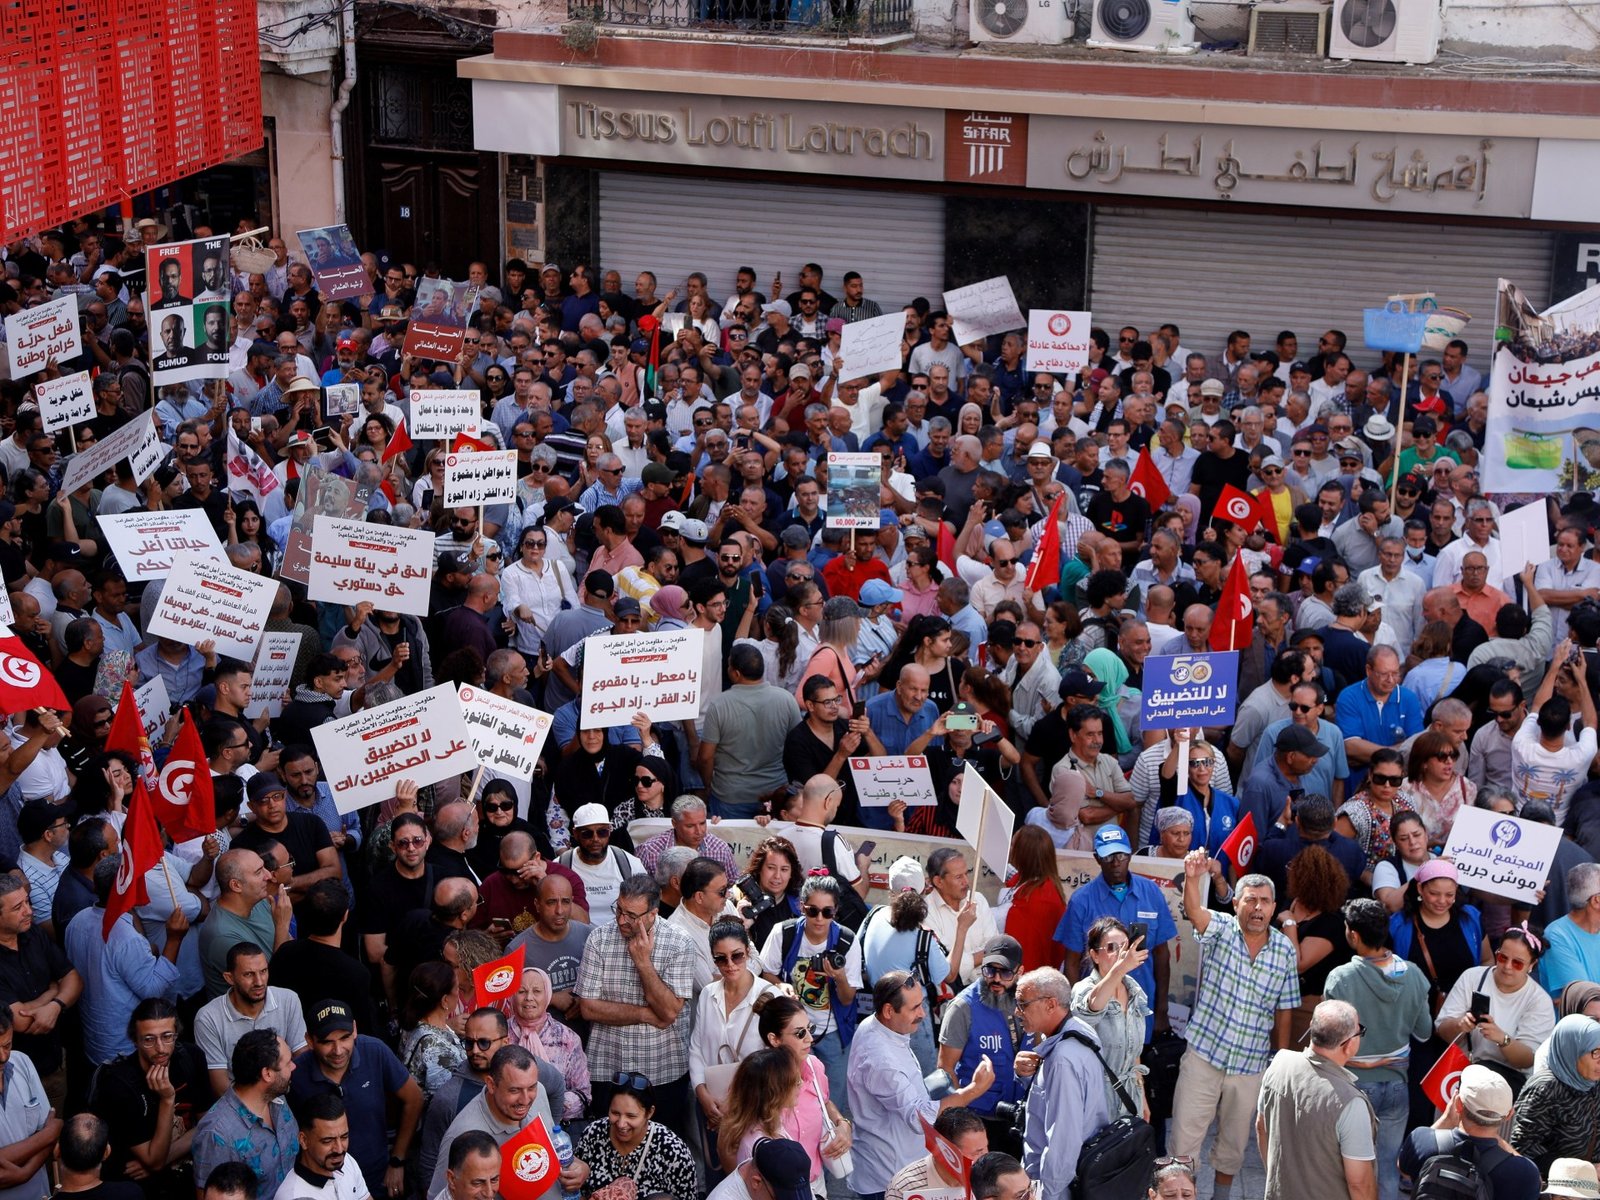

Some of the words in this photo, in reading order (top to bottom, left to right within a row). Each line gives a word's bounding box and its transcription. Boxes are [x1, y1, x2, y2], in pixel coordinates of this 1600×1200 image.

[568, 100, 675, 144] Tissus
[685, 105, 775, 150] Lotfi
[784, 112, 934, 161] Latrach
[1214, 140, 1360, 200] لطفي
[1373, 139, 1495, 208] أقمشة
[401, 208, 410, 217] 18
[160, 247, 180, 256] FREE
[205, 241, 221, 250] THE
[48, 319, 73, 341] شغل
[48, 338, 75, 356] كرامة
[415, 341, 437, 350] العثماني
[1029, 340, 1049, 349] عادلة
[1051, 341, 1080, 351] محاكمة
[17, 349, 45, 368] وطنية
[158, 357, 188, 368] SUMUD
[1033, 360, 1044, 368] حر
[1046, 359, 1063, 370] دفاع
[1065, 360, 1080, 370] دون
[1508, 365, 1572, 388] جيعان
[70, 388, 83, 401] شغل
[1506, 389, 1565, 412] شبعان
[71, 404, 91, 418] كرامة
[419, 405, 432, 416] عمال
[475, 469, 480, 480] يا
[482, 468, 504, 480] مواطن
[505, 466, 511, 478] يا
[447, 491, 467, 503] الجوع
[468, 490, 481, 500] زاد
[482, 488, 500, 501] الفقر
[502, 488, 514, 498] زاد
[128, 534, 164, 555] أغلى
[165, 537, 209, 552] حياتنا
[314, 552, 351, 568] سليمة
[354, 555, 376, 573] بيئة
[378, 563, 398, 578] في
[401, 565, 427, 578] الحق
[175, 585, 196, 596] الفلاحة
[333, 578, 382, 591] دستوري
[385, 582, 404, 596] حق
[162, 594, 193, 612] تهميشا
[210, 597, 221, 606] في
[221, 598, 242, 610] العاملة
[190, 604, 210, 617] كفى
[241, 619, 261, 632] كفى
[234, 632, 254, 645] كفى
[625, 639, 636, 647] أجل
[603, 641, 624, 650] الكرامة
[688, 670, 697, 682] يا
[1170, 656, 1212, 685] 50
[592, 676, 628, 691] مقموع
[630, 675, 639, 688] يا
[651, 672, 686, 686] معطل
[681, 691, 696, 704] زاد
[1148, 686, 1212, 707] للتضييق
[1215, 685, 1227, 699] لا
[415, 695, 435, 706] مقاومة
[590, 697, 625, 714] الجوع
[628, 696, 642, 709] زاد
[653, 692, 679, 708] الفقر
[376, 712, 385, 720] من
[386, 704, 407, 715] مقاومة
[1146, 708, 1174, 721] المدني
[1176, 706, 1208, 719] المجتمع
[1210, 705, 1226, 715] على
[334, 719, 360, 733] الكرامة
[363, 715, 374, 725] أجل
[421, 728, 432, 742] لا
[497, 722, 526, 740] تطبق
[364, 733, 418, 765] لتضييق
[434, 739, 467, 760] على
[478, 745, 494, 761] في
[494, 749, 525, 768] المعطل
[334, 749, 431, 792] الصحفيين/ات
[524, 762, 531, 774] و
[876, 760, 904, 771] شغل
[873, 773, 914, 785] حرية
[863, 788, 897, 799] وطنية
[900, 788, 932, 799] كرامة
[1451, 843, 1492, 858] المدني
[1493, 853, 1544, 871] المجتمع
[1491, 870, 1537, 889] موش
[317, 1007, 330, 1021] TOP
[331, 1006, 346, 1016] GUN
[980, 1034, 1002, 1053] snjt
